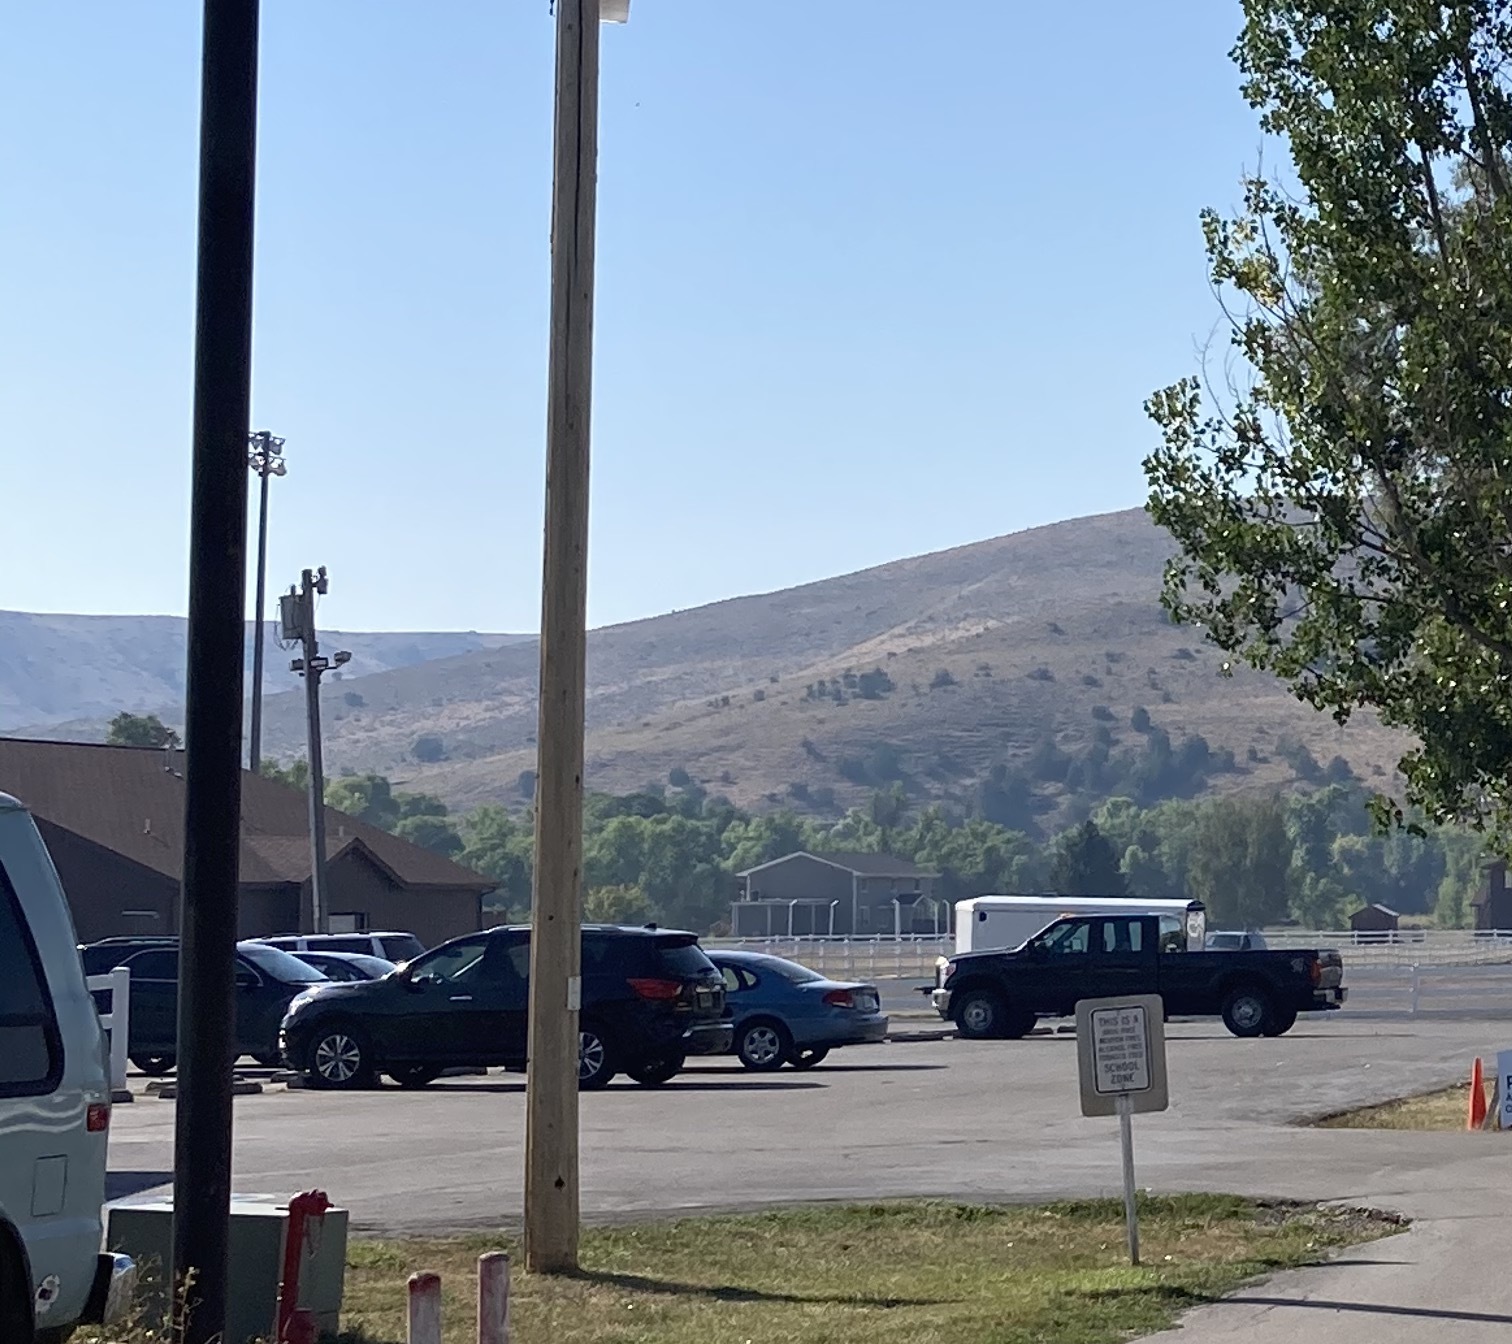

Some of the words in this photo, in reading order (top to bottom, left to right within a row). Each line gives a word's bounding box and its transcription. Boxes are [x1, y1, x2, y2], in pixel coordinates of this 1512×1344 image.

[1098, 1017, 1118, 1027] THIS
[1121, 1016, 1131, 1026] IS
[1104, 1062, 1140, 1073] SCHOOL
[1111, 1074, 1135, 1085] ZONE
